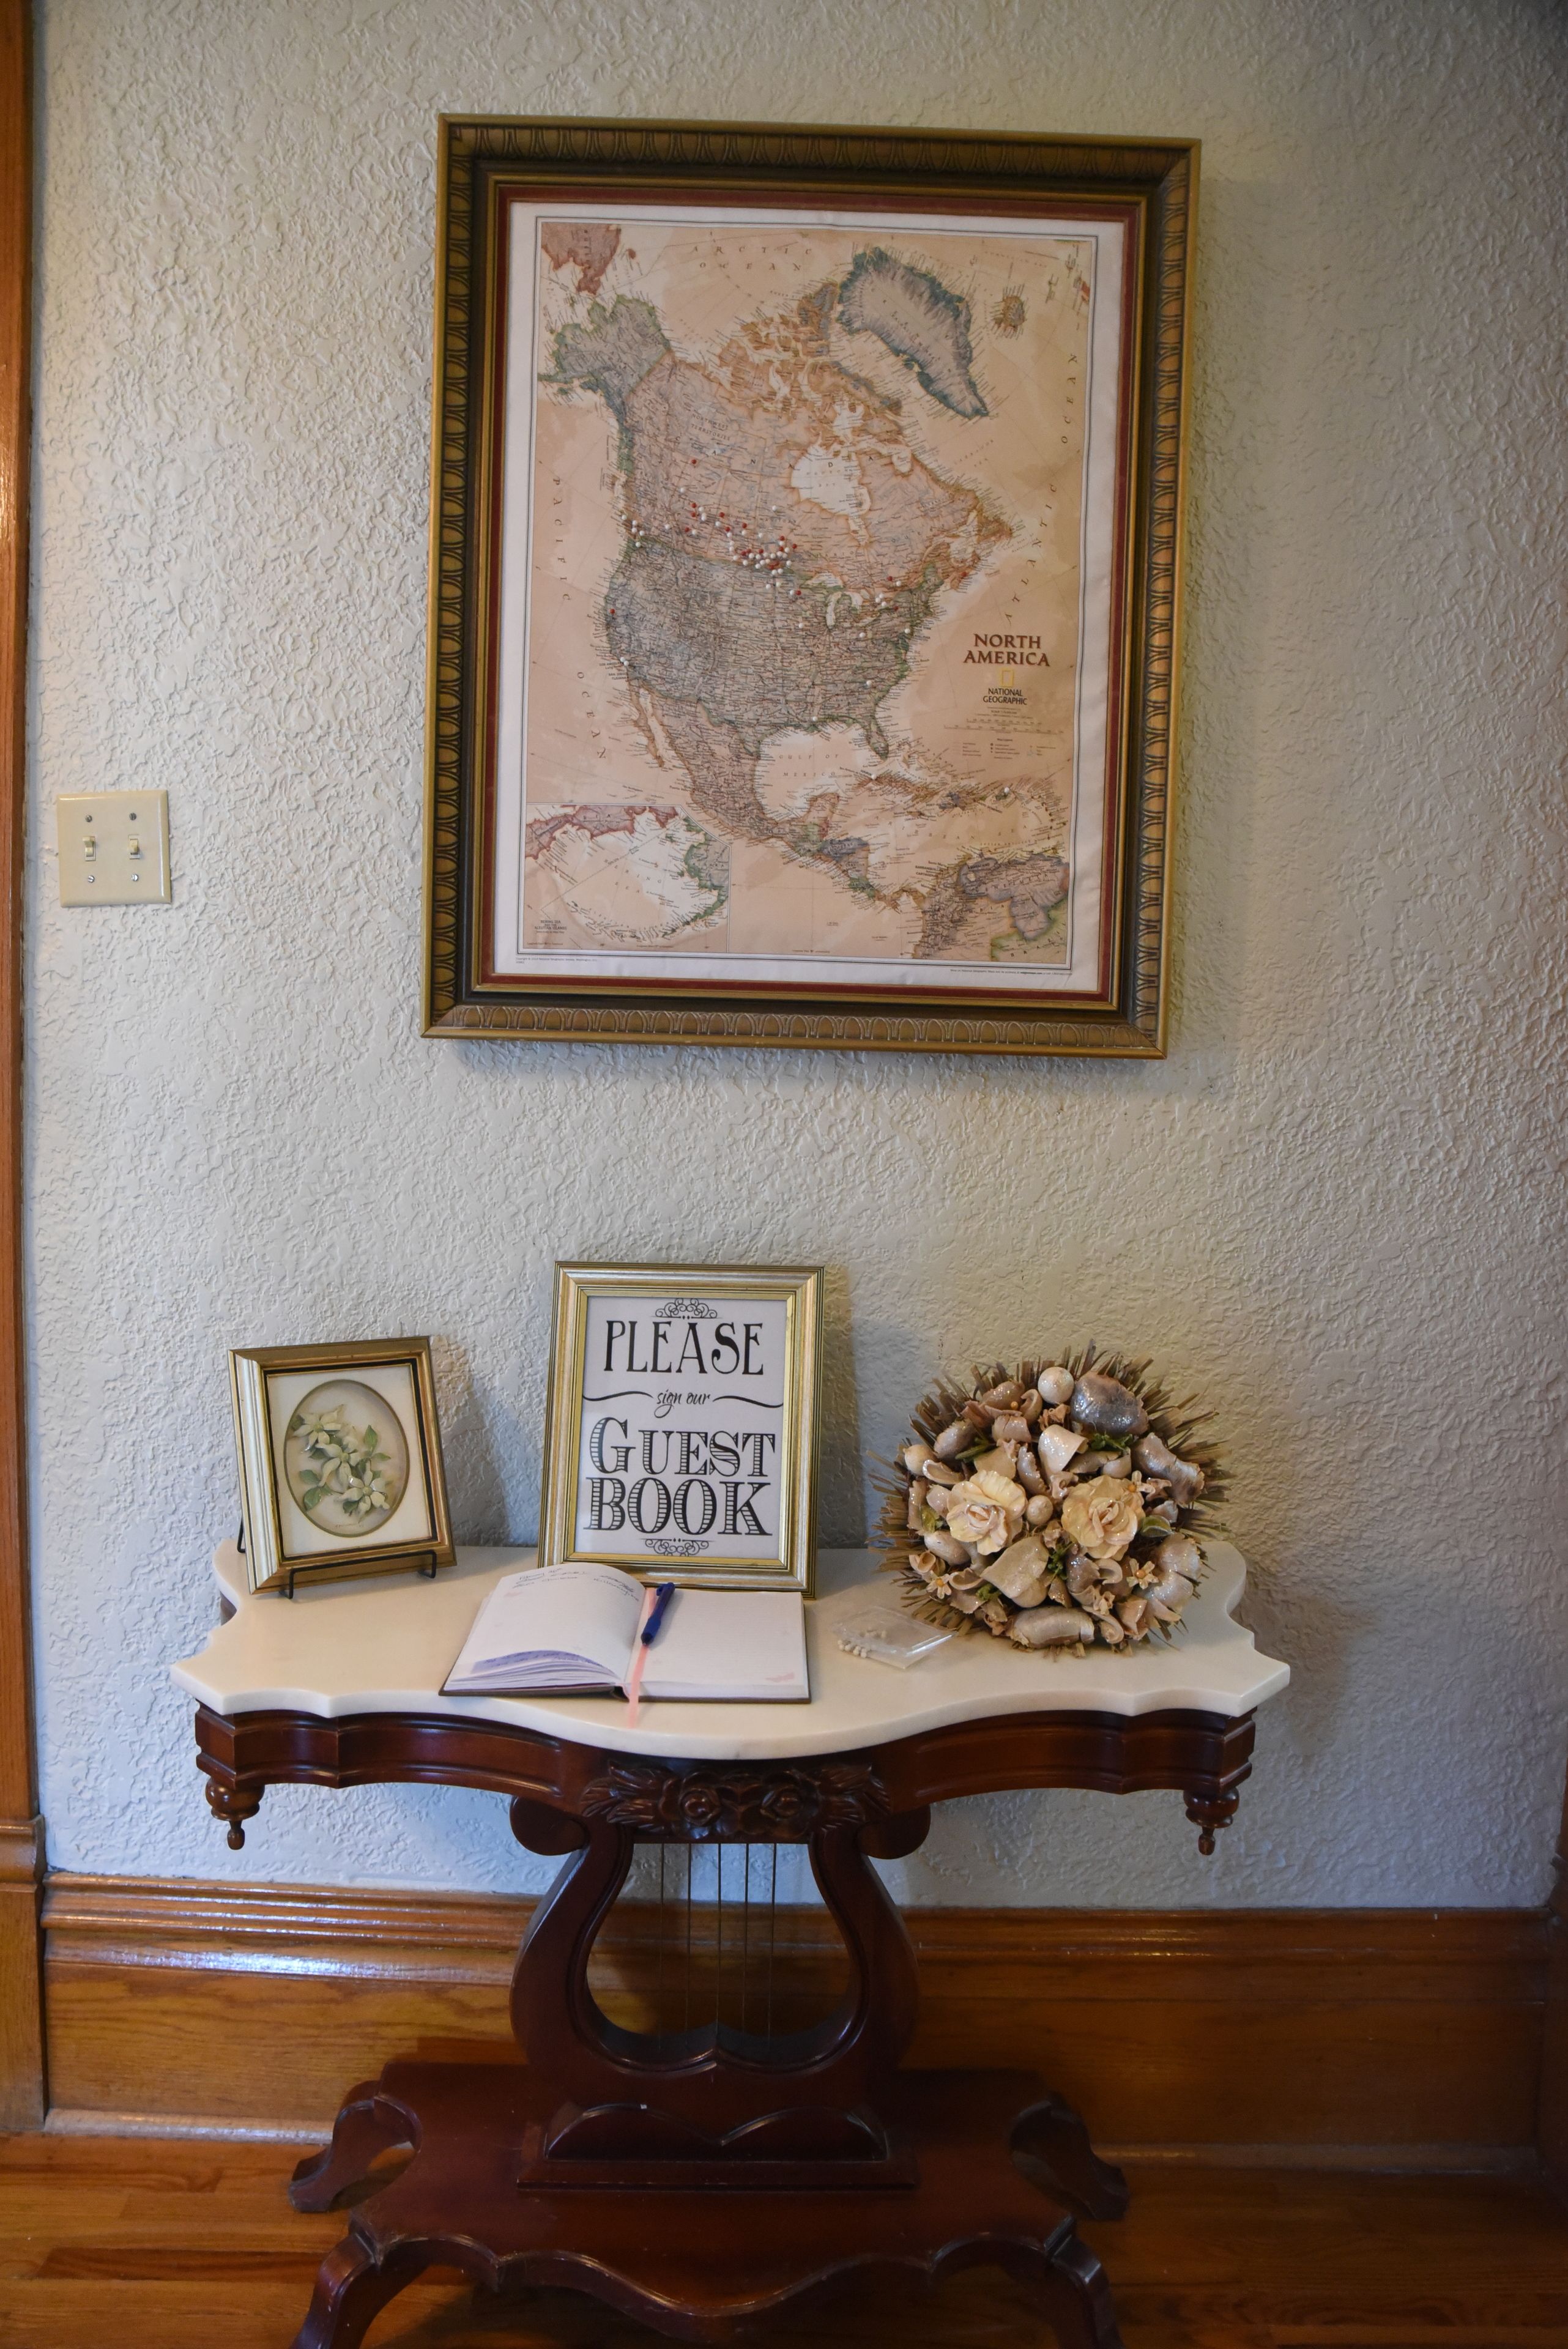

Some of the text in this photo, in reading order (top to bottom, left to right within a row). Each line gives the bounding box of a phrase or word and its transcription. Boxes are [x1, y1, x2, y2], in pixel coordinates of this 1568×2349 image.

[690, 246, 812, 255] ARCTIC
[699, 262, 801, 271] OCEAN
[1005, 484, 1057, 626] ATLANTIC
[1060, 354, 1079, 444] OCEAN
[553, 478, 606, 759] PACIFIC OCEAN
[973, 633, 1041, 649] NORTH
[963, 650, 1050, 666] AMERICA
[983, 696, 1028, 705] GEOGRAPHIC
[988, 688, 1023, 697] NATIONAL
[604, 1320, 764, 1375] PLEASE
[654, 1389, 710, 1419] sign our
[590, 1417, 776, 1477] GUEST
[583, 1477, 773, 1536] BOOK
